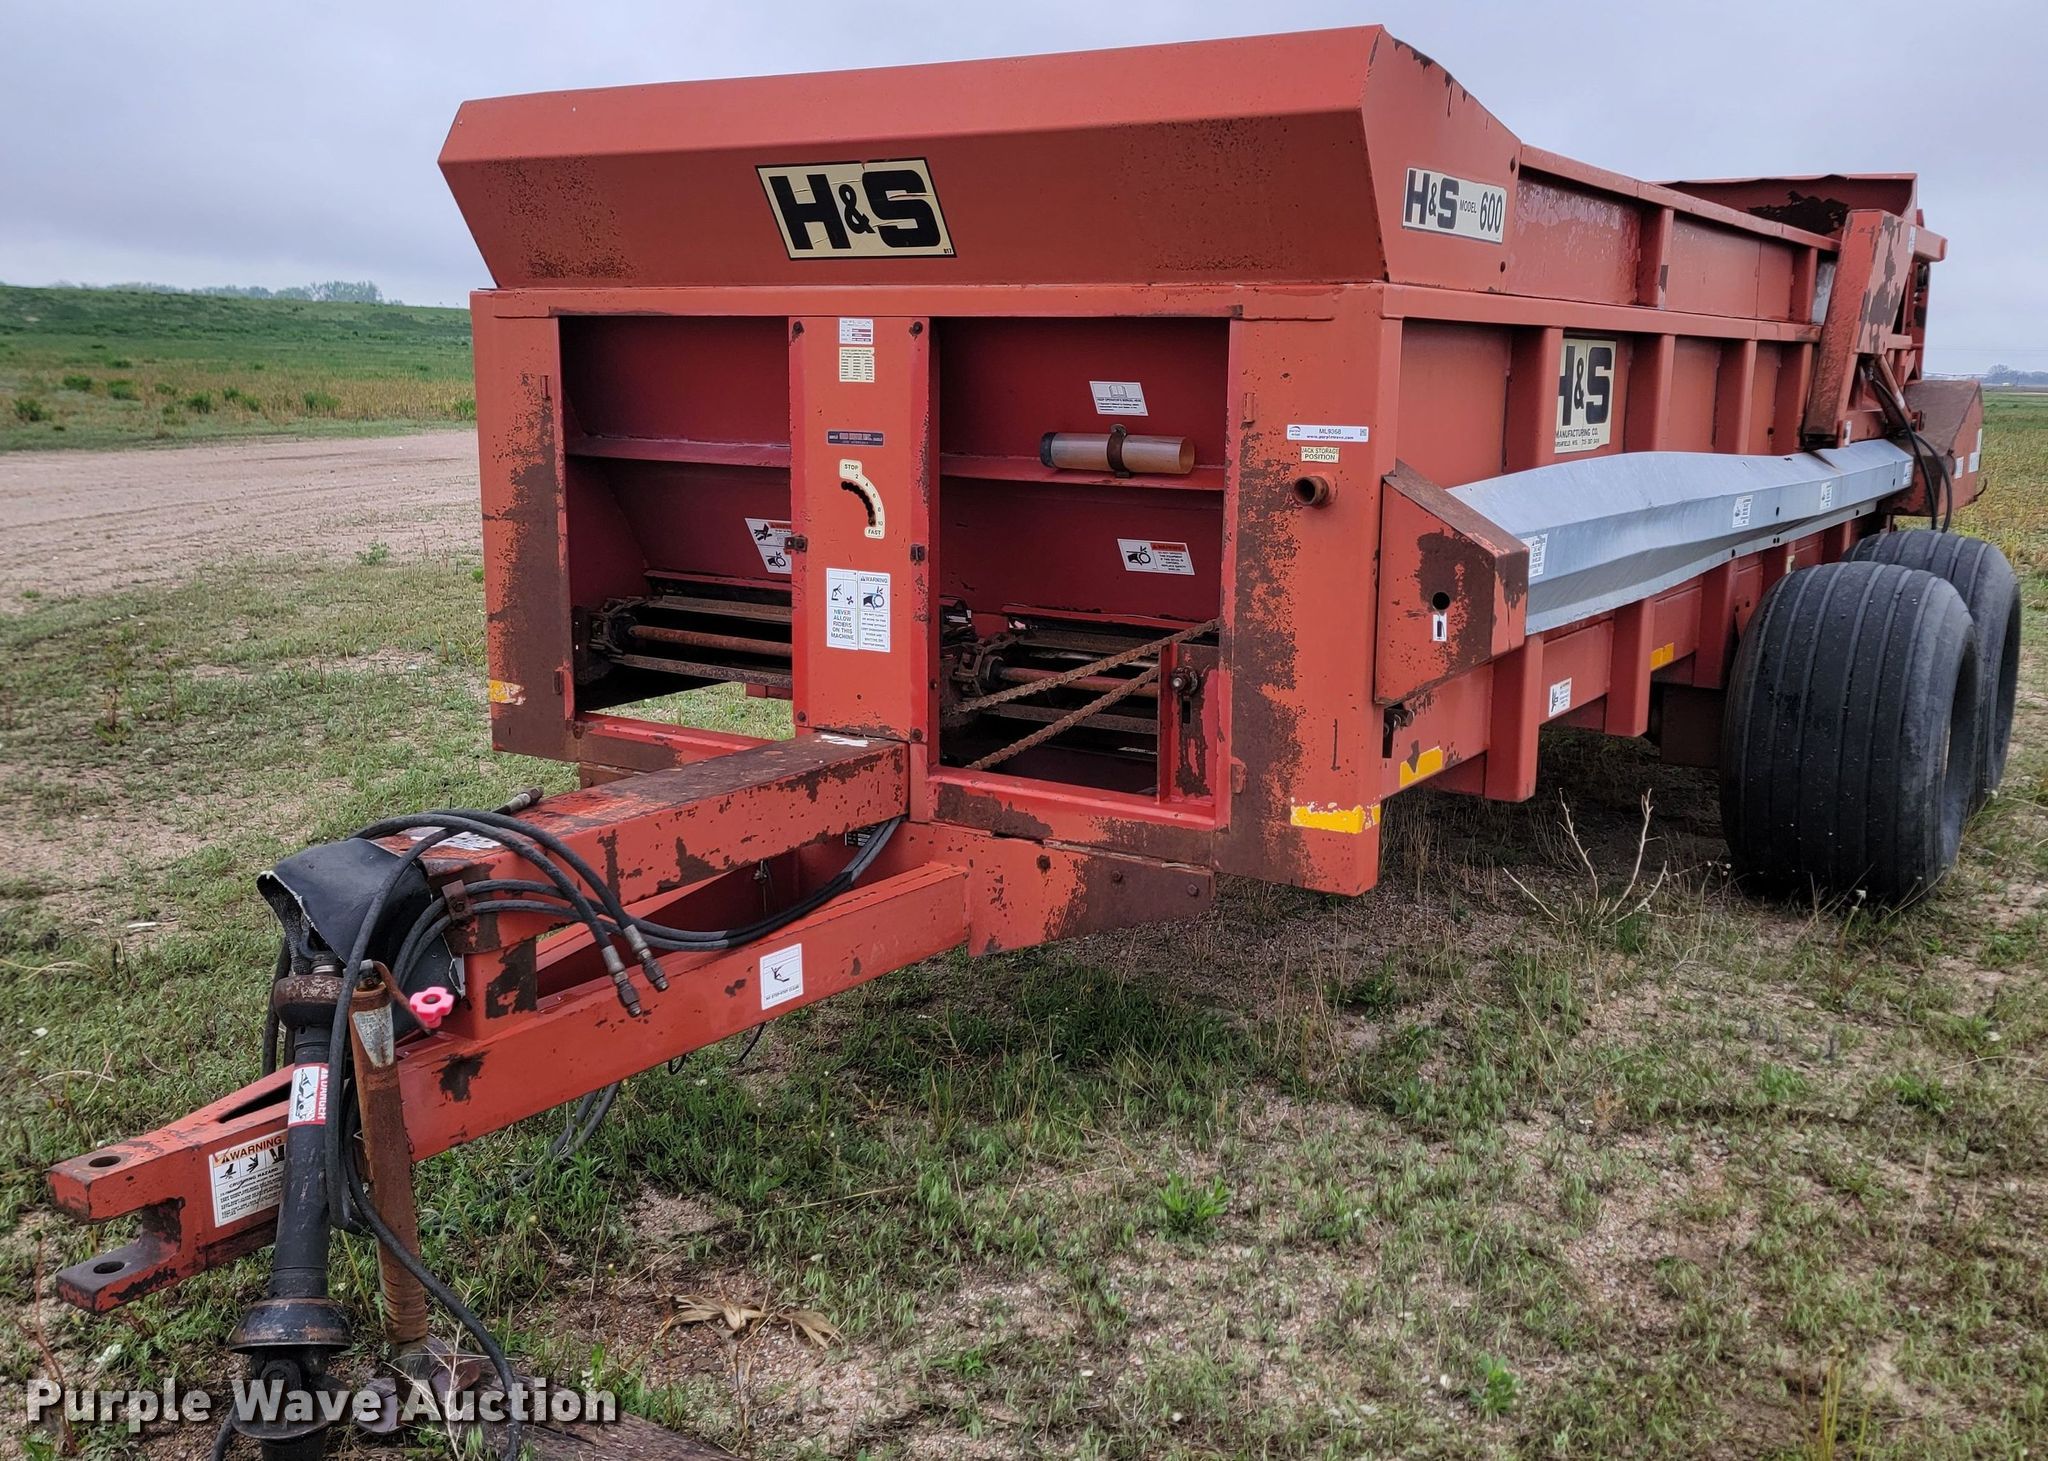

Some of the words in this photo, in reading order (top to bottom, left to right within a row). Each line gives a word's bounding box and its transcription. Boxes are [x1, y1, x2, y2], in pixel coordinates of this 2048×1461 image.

[768, 169, 941, 250] H&S
[1405, 169, 1459, 229] H&S
[1480, 191, 1503, 233] 600
[230, 1136, 282, 1160] WARNING
[257, 1167, 279, 1178] HAZARD
